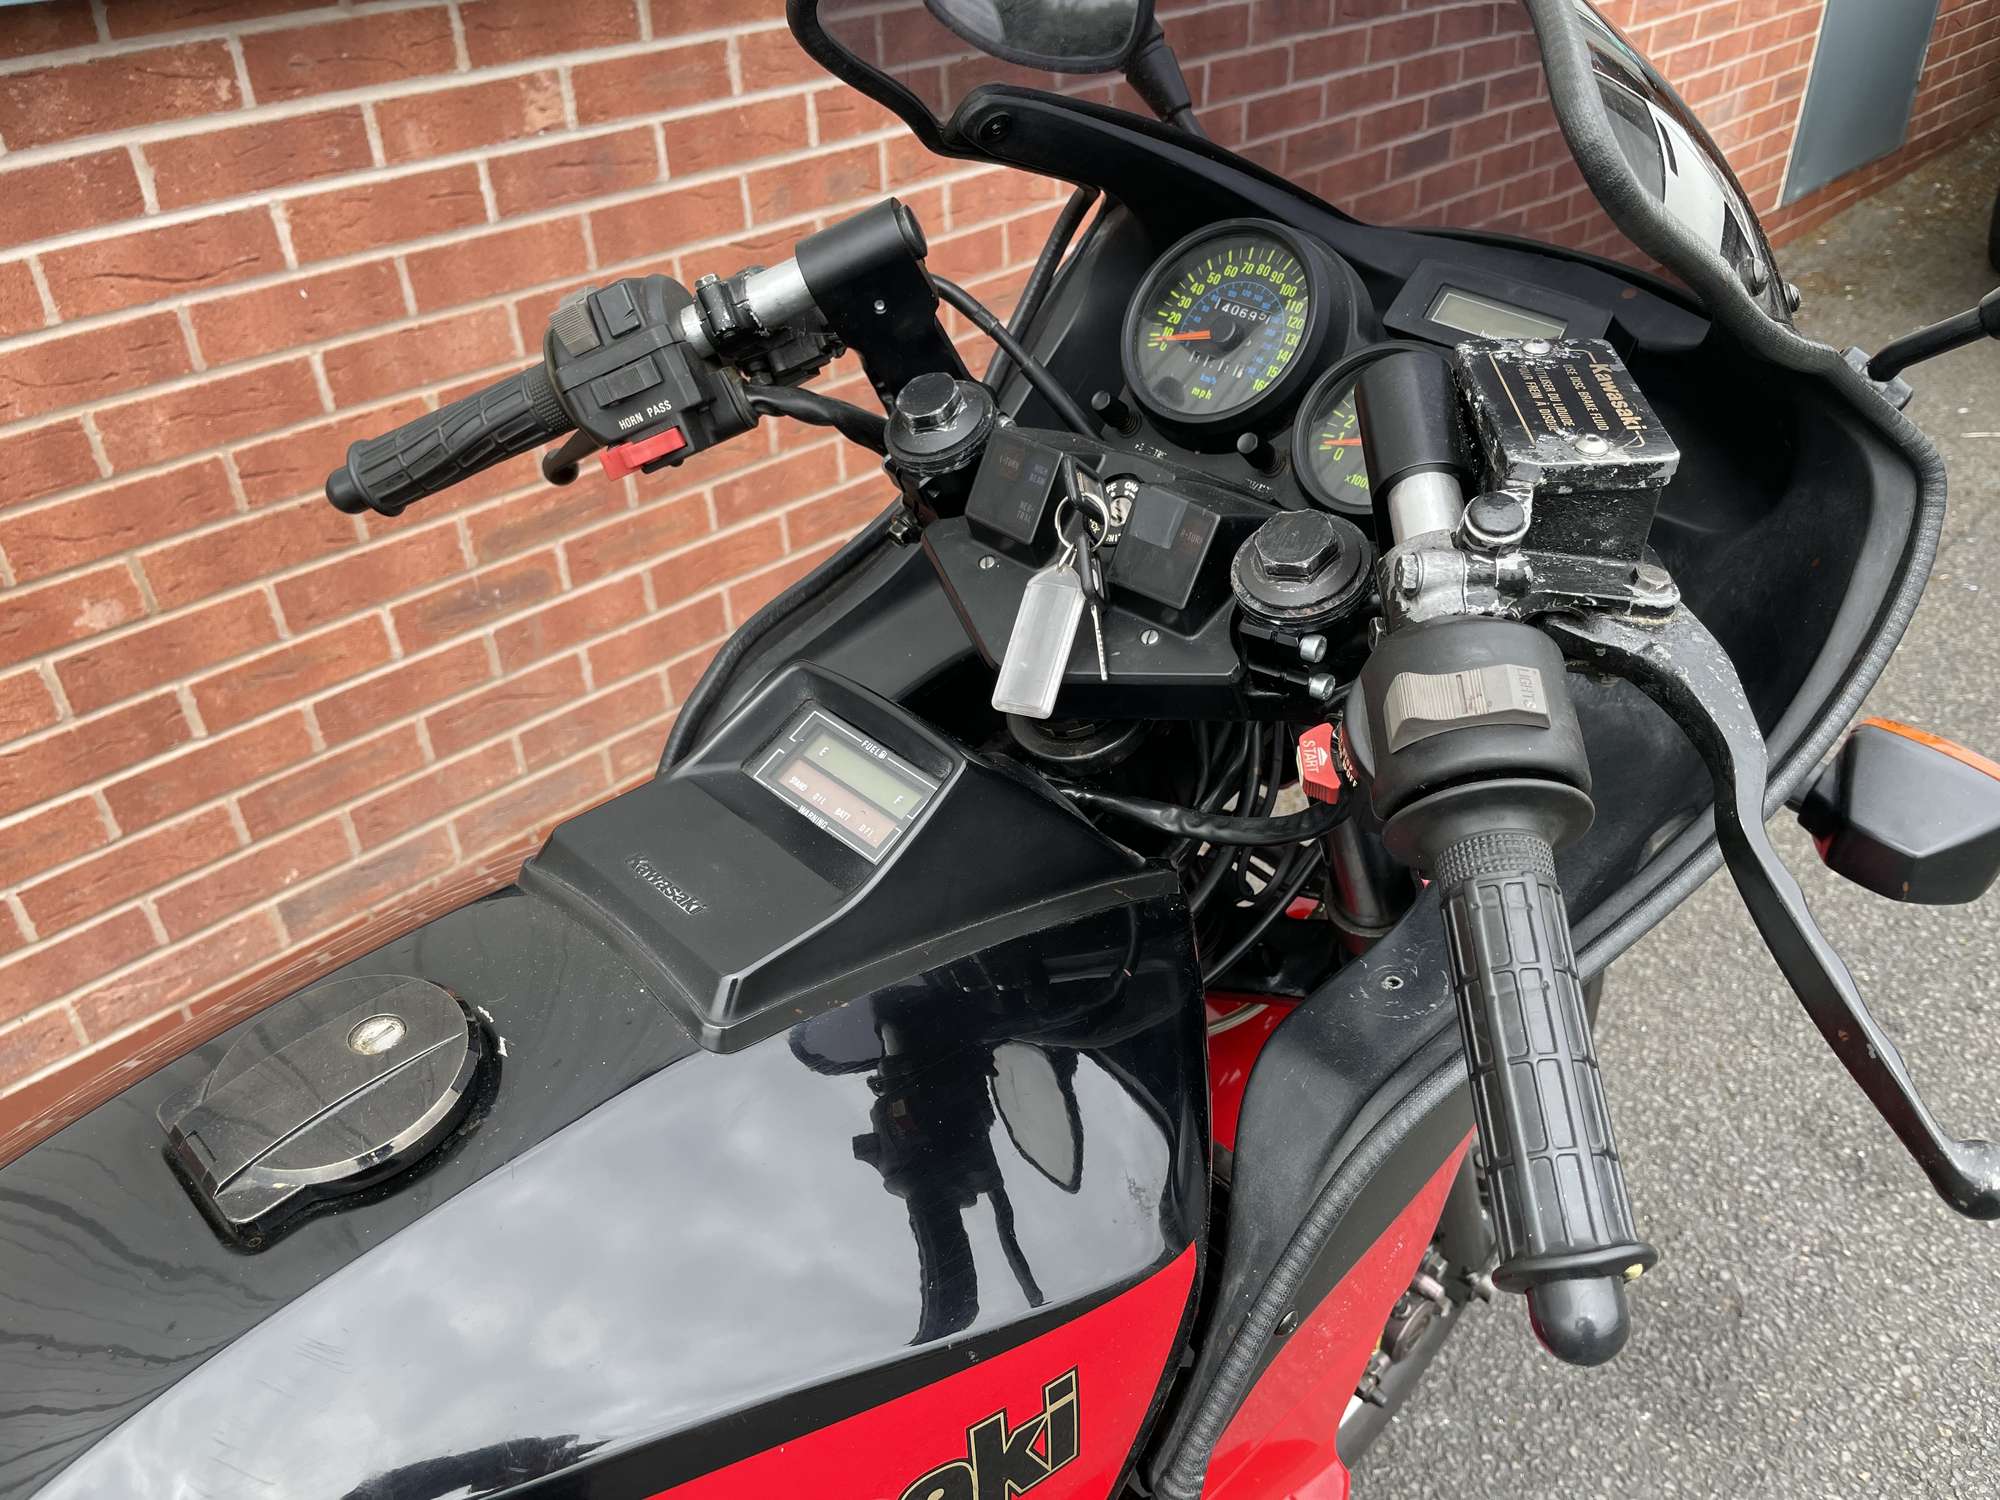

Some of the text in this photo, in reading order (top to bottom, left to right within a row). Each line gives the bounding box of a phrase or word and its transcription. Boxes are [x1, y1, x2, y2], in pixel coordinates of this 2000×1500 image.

[1224, 266, 1238, 278] 60
[1241, 262, 1254, 275] 70
[1256, 264, 1271, 277] 80
[1207, 273, 1222, 285] 50
[1269, 271, 1285, 284] 90
[1190, 283, 1205, 296] 40
[1279, 283, 1298, 298] 100
[1177, 295, 1192, 309] 30
[1285, 300, 1304, 314] 110
[1167, 312, 1182, 325] 20
[1286, 316, 1305, 330] 120
[1267, 365, 1282, 379] 15
[1191, 386, 1213, 400] mph
[1525, 380, 1544, 400] FREIN
[1588, 362, 1648, 432] Kawasaki
[1563, 363, 1610, 432] USE DISC BRAKE FLUID
[618, 399, 672, 430] HORN PASS
[1343, 414, 1356, 429] 2
[1333, 447, 1345, 461] 0
[1515, 668, 1538, 710] LIGHTS
[861, 740, 880, 756] FUEL
[1302, 738, 1320, 774] START
[797, 805, 829, 830] WARNING
[625, 853, 706, 916] Kawasaki
